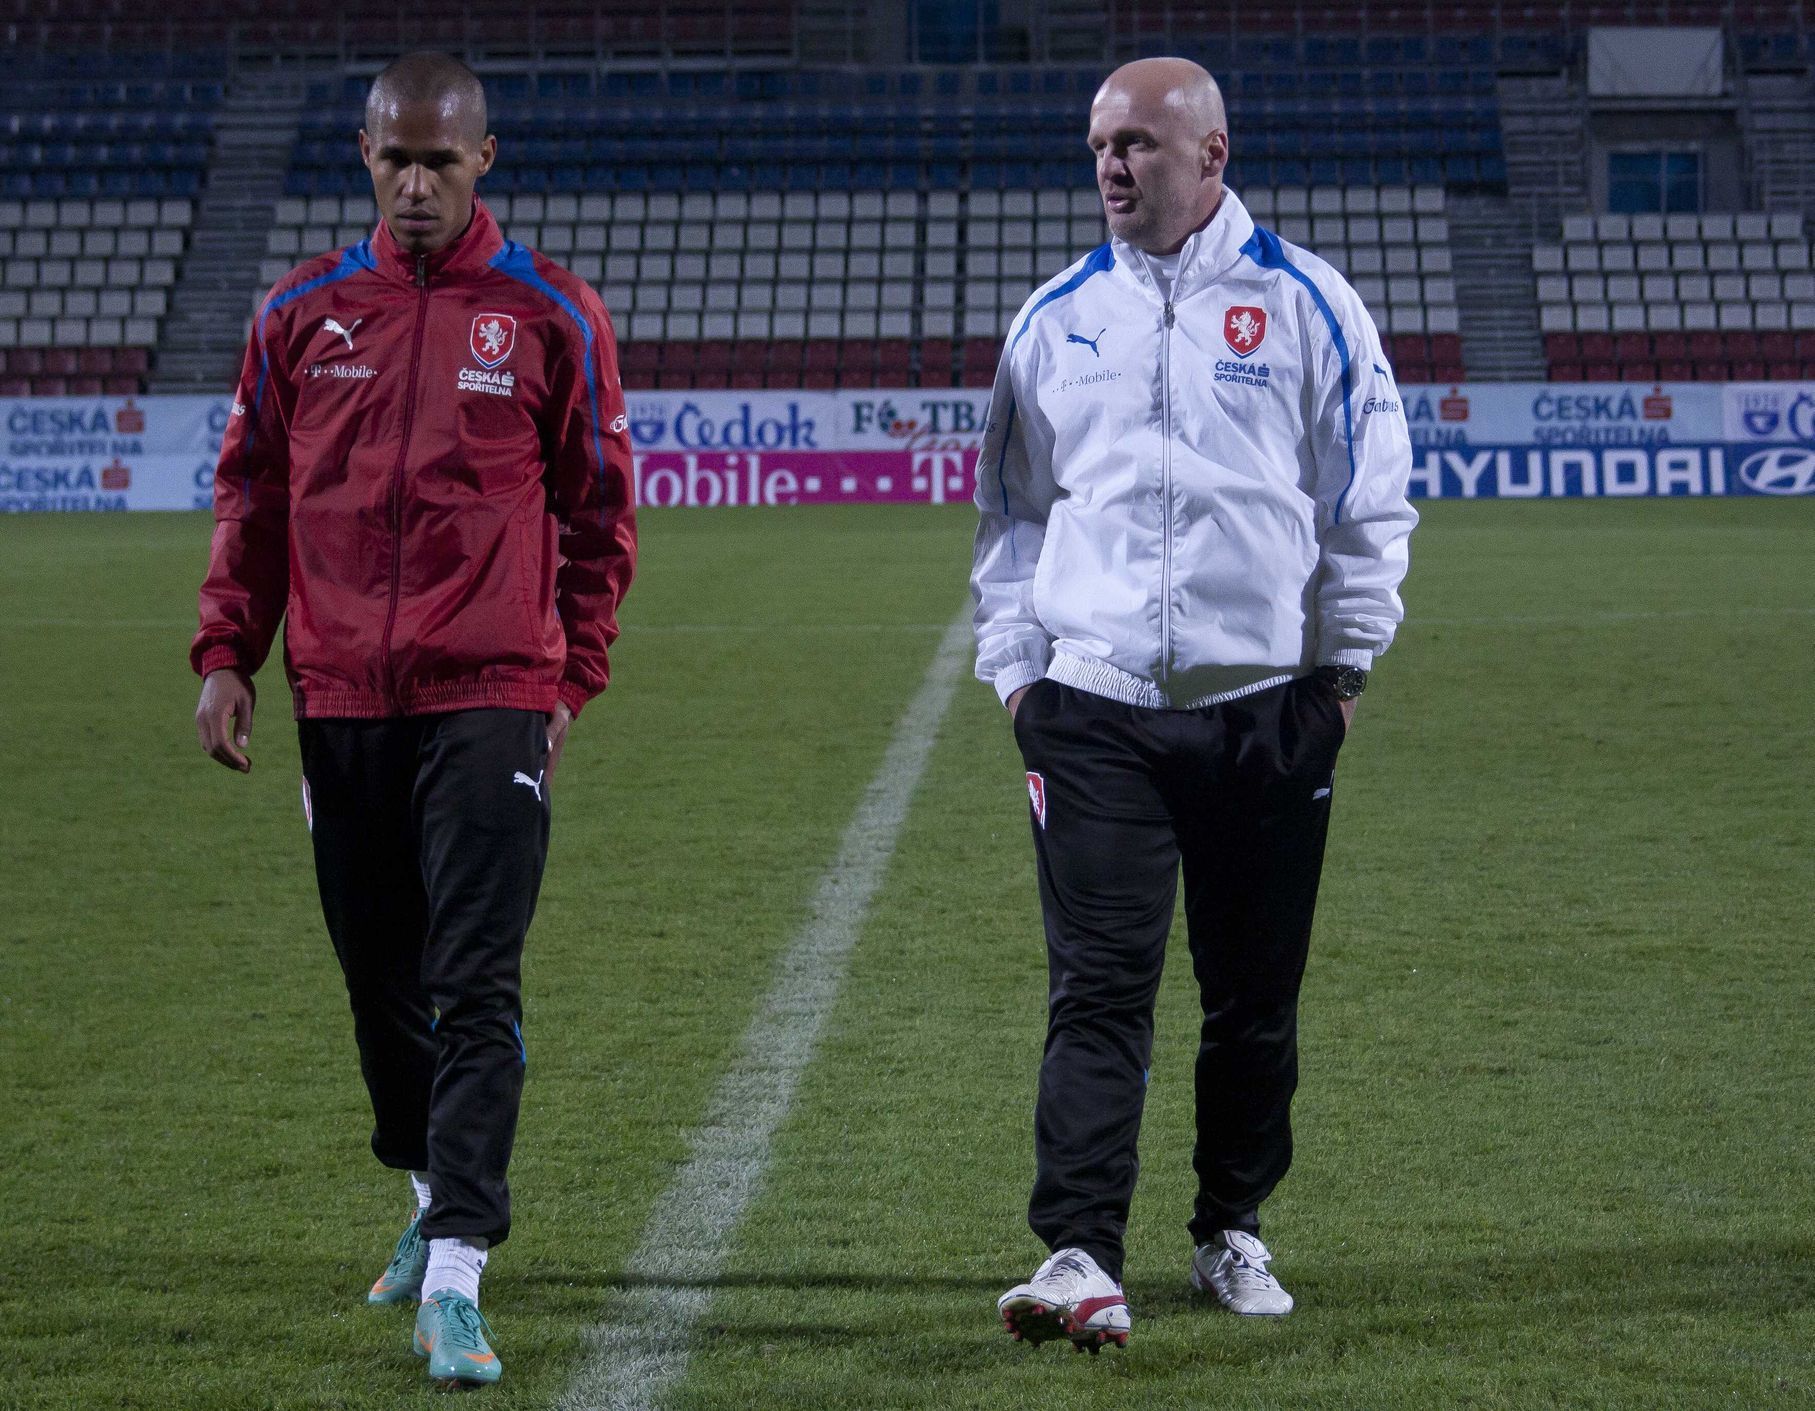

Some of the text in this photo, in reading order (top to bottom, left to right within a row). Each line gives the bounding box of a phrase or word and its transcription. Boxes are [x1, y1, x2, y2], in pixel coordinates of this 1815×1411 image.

[458, 367, 501, 385] ČESKÁ
[1215, 359, 1256, 376] ČESKÁ
[457, 380, 512, 397] SPOŘITELNA
[1214, 372, 1267, 388] SPOŘITELNA
[1531, 389, 1638, 422] ČESKÁ
[1408, 448, 1726, 498] HYUNDAI
